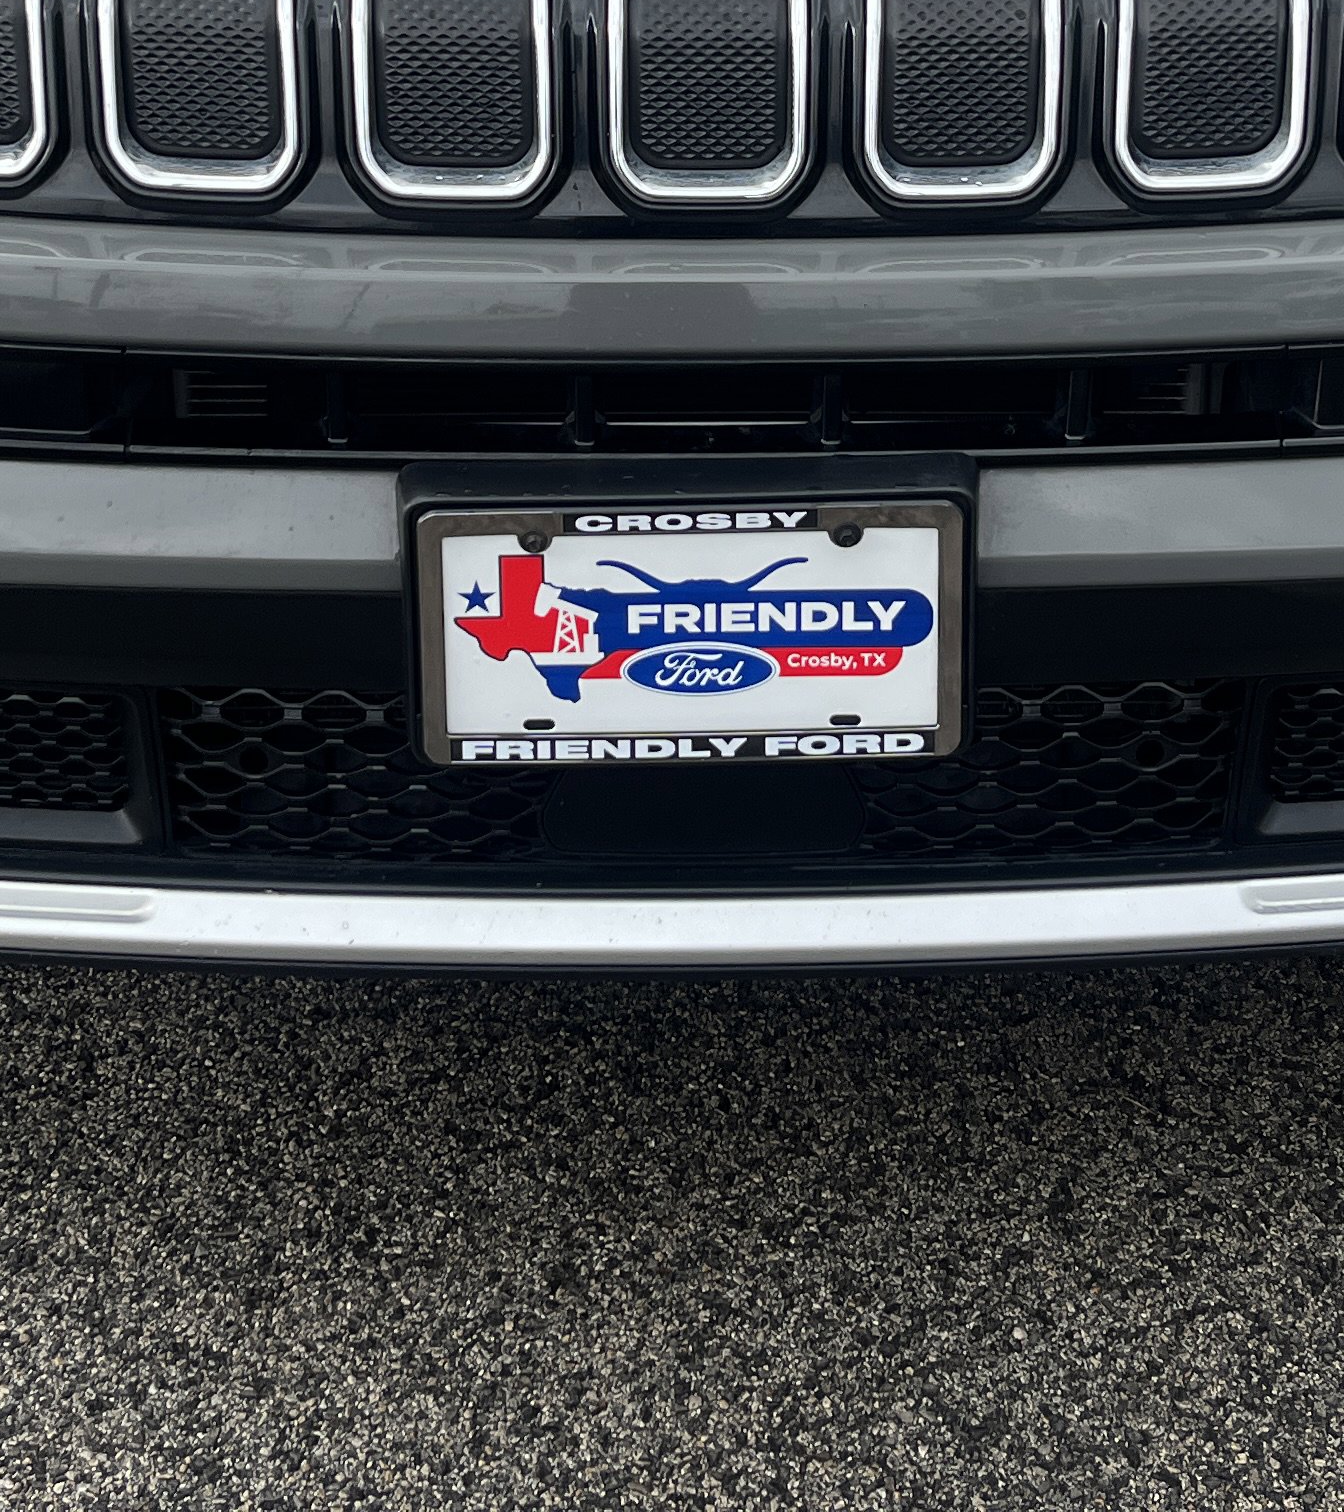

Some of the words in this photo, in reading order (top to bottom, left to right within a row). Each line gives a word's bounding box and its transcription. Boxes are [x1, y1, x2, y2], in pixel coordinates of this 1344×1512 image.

[575, 510, 808, 533] CROSBY
[626, 600, 907, 635] FRIENDLY
[654, 650, 745, 687] Ford
[787, 652, 858, 671] Crosby,
[860, 652, 887, 668] TX
[461, 737, 748, 761] FRIENDLY
[764, 732, 926, 757] FORD
